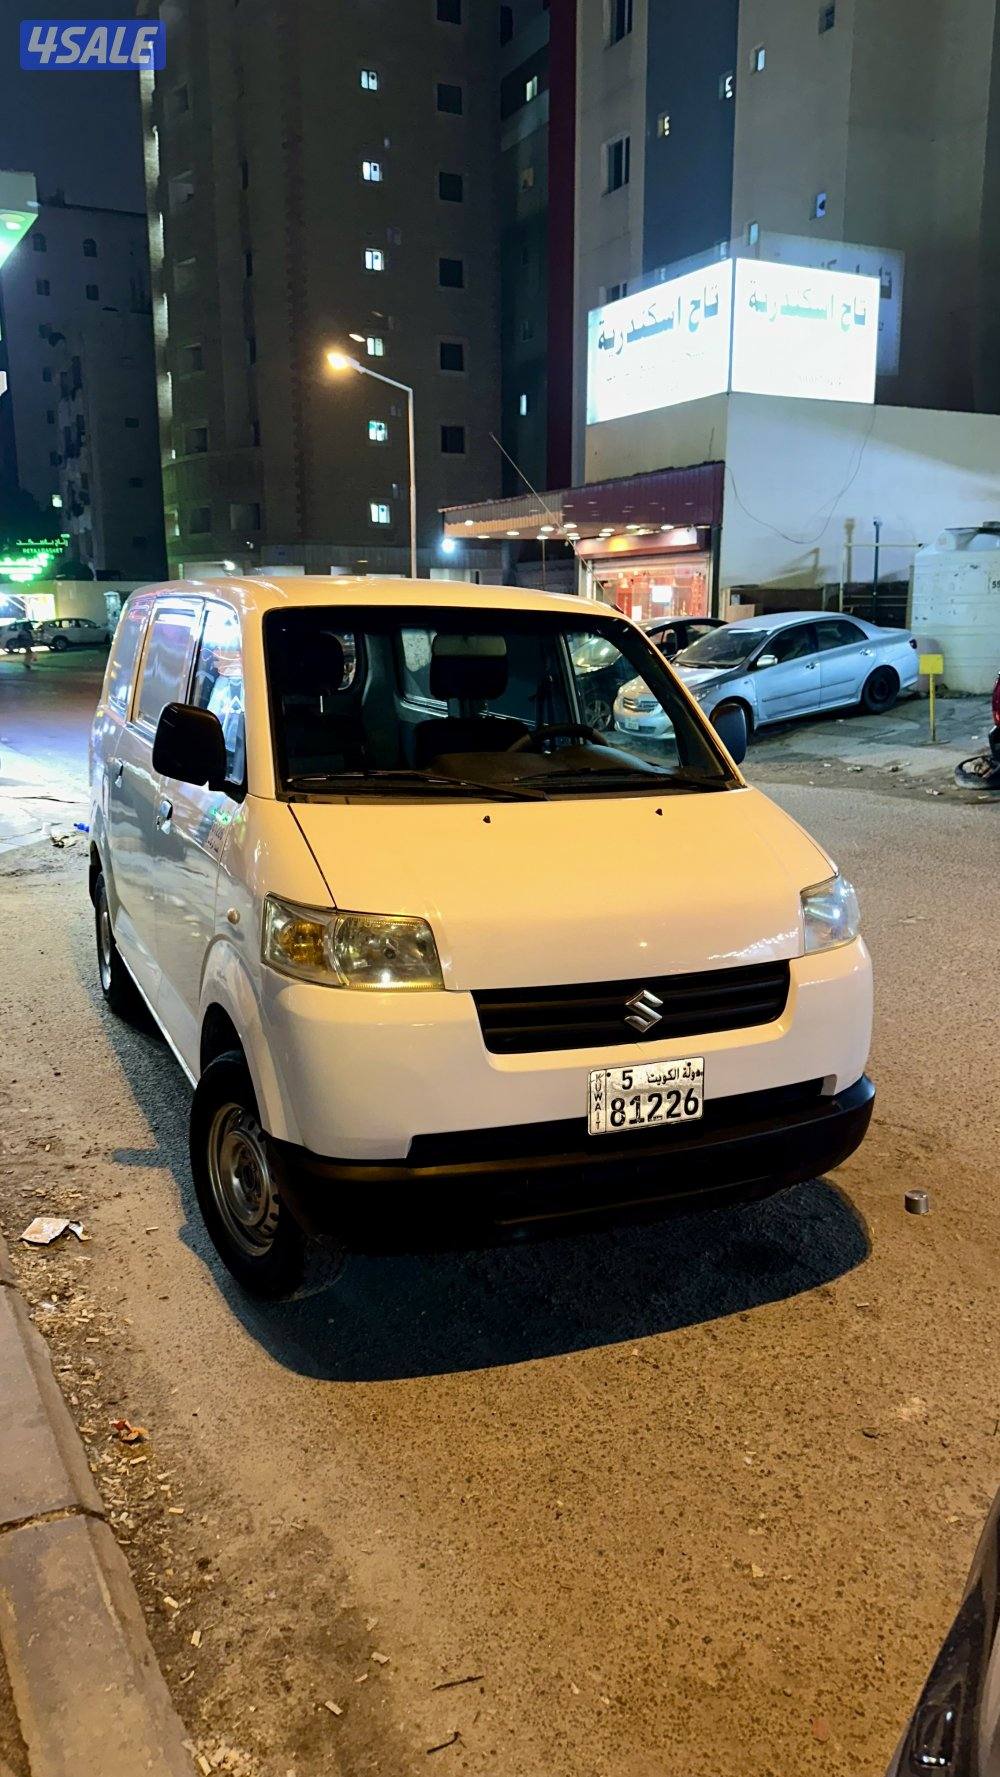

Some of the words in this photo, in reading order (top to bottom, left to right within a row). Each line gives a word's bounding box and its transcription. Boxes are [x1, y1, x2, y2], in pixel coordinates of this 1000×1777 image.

[688, 284, 718, 333] تاج
[621, 1069, 634, 1090] 5
[646, 1068, 680, 1085] الكويت
[682, 1067, 703, 1081] دولة
[594, 1073, 604, 1130] KUWAIT
[610, 1087, 699, 1127] 81226
